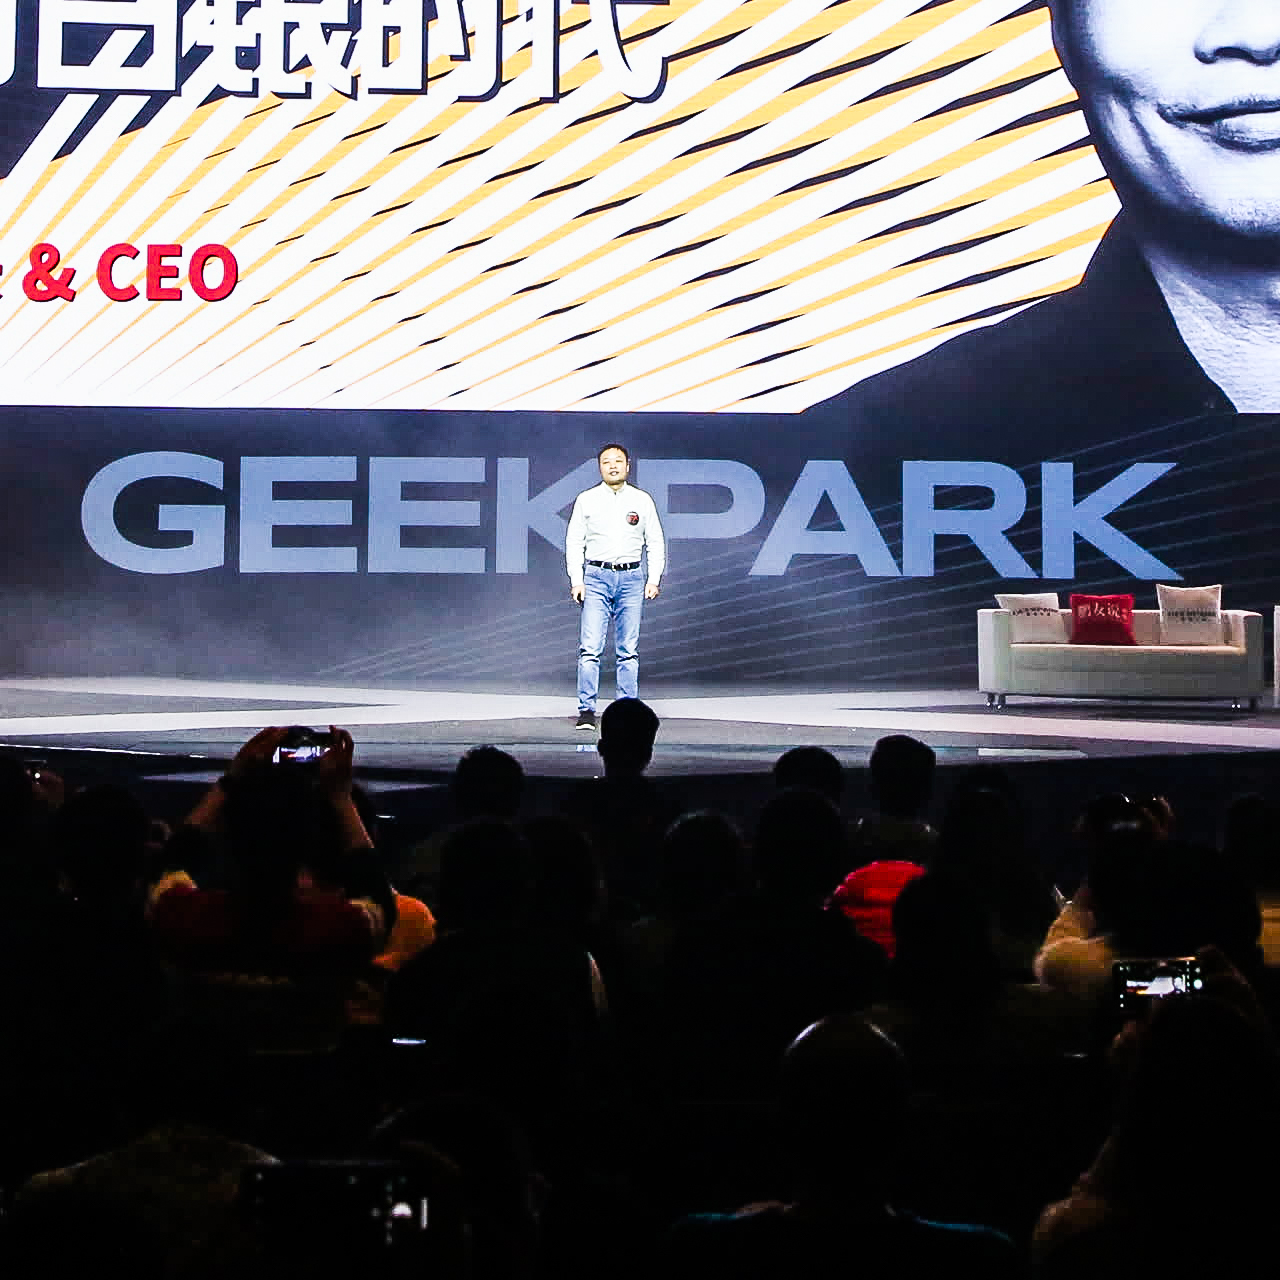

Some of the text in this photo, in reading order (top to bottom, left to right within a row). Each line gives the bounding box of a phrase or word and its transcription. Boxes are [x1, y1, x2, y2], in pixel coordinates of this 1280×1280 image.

[21, 242, 76, 303] &
[96, 241, 238, 302] CEO
[81, 451, 1184, 580] GEEKPARK
